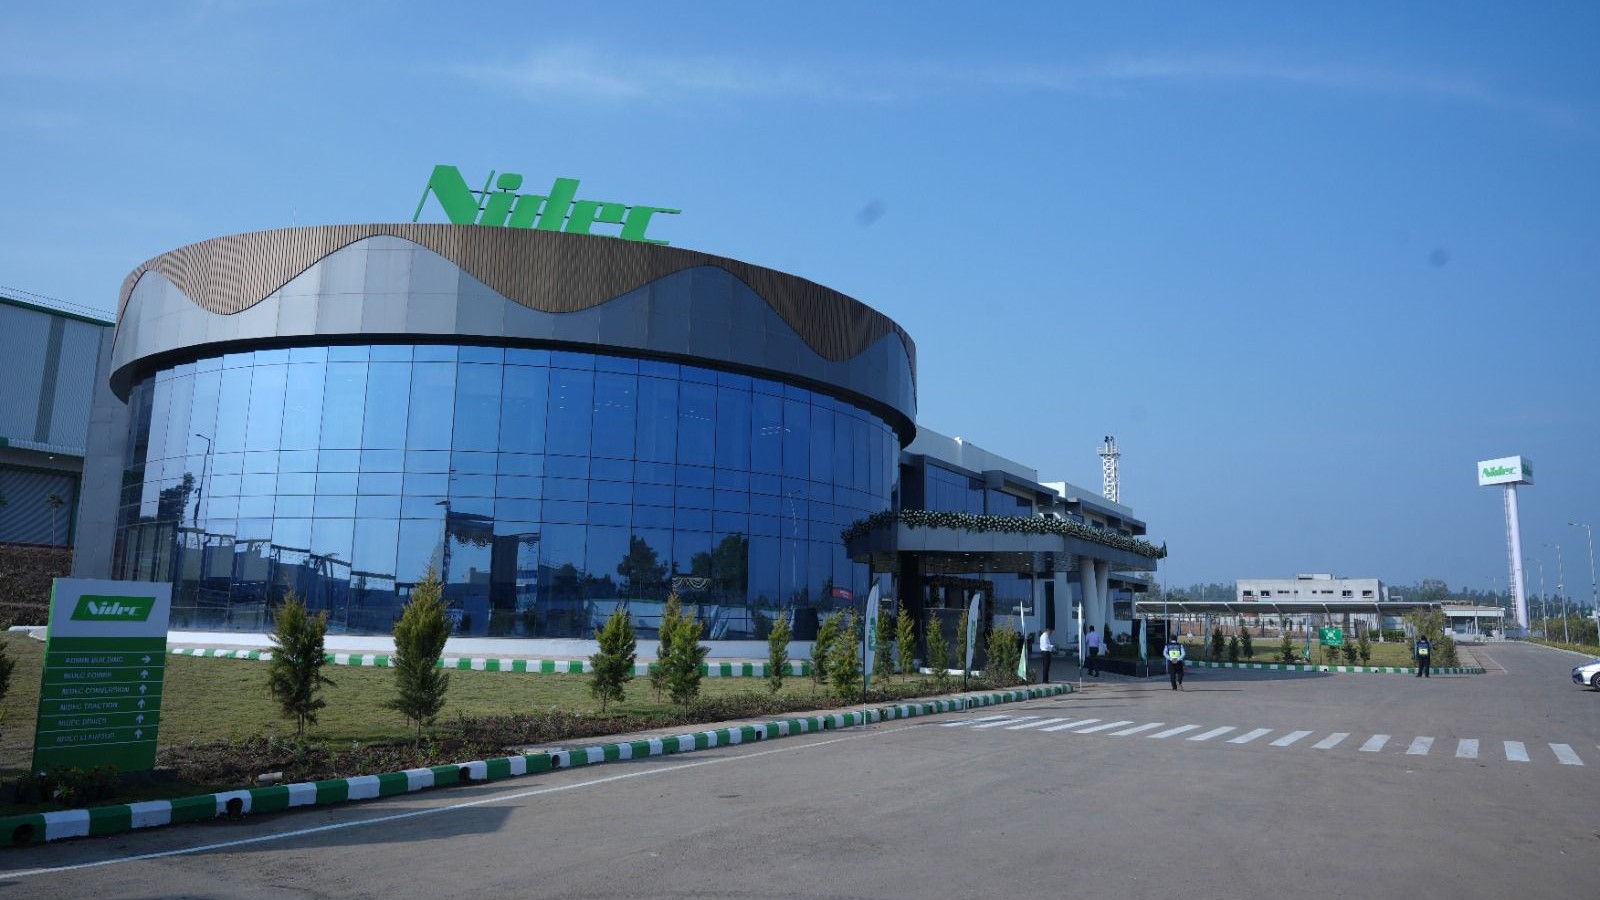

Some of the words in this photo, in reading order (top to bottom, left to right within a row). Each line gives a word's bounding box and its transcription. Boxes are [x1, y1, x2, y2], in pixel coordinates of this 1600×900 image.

[413, 165, 682, 245] Nidec
[1482, 466, 1517, 478] Nidec
[84, 601, 144, 616] Nidec
